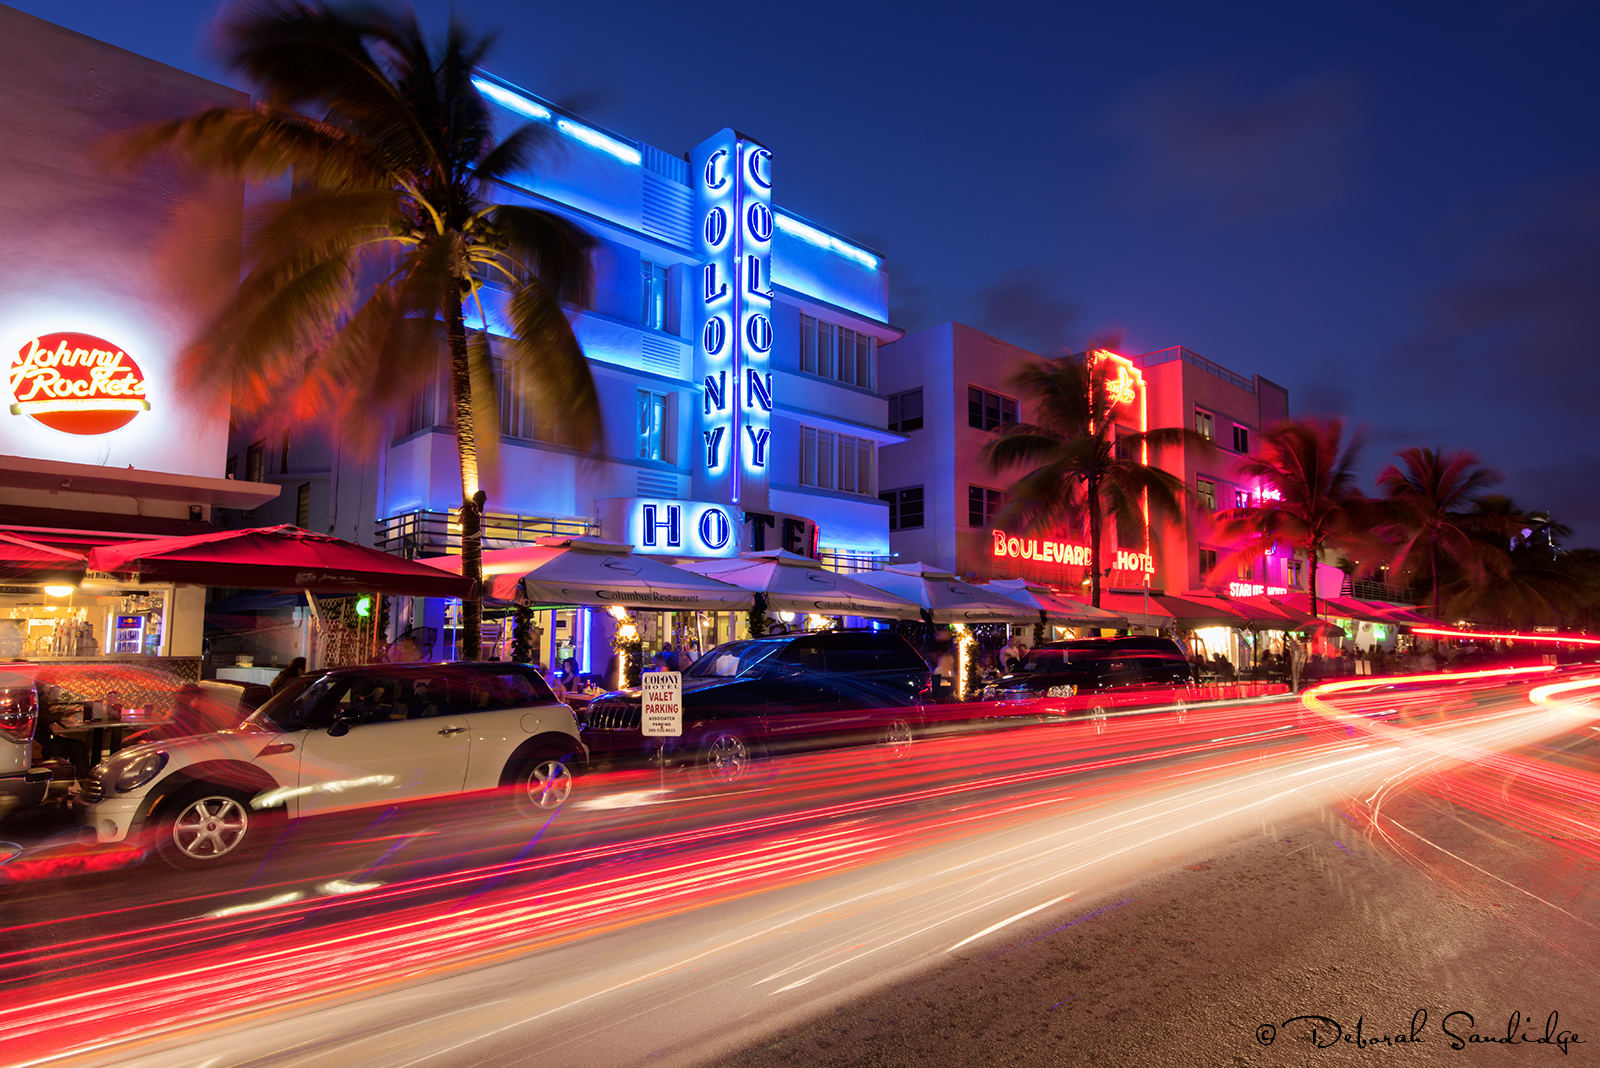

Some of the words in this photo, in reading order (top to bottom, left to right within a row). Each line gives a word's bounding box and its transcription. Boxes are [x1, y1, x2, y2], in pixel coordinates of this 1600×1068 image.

[704, 150, 727, 469] COLONY
[745, 147, 774, 468] COLONY
[9, 338, 132, 393] Johnny
[19, 367, 147, 400] Rockets
[992, 529, 1092, 566] BOULEVARD
[1117, 550, 1155, 574] HOTEL
[595, 590, 652, 601] Columbus
[652, 591, 699, 603] Restaurant
[814, 601, 851, 611] Columbus
[851, 602, 884, 613] Restaurant
[644, 675, 678, 684] COLONY
[649, 692, 673, 701] VALET
[645, 704, 679, 714] PARKING
